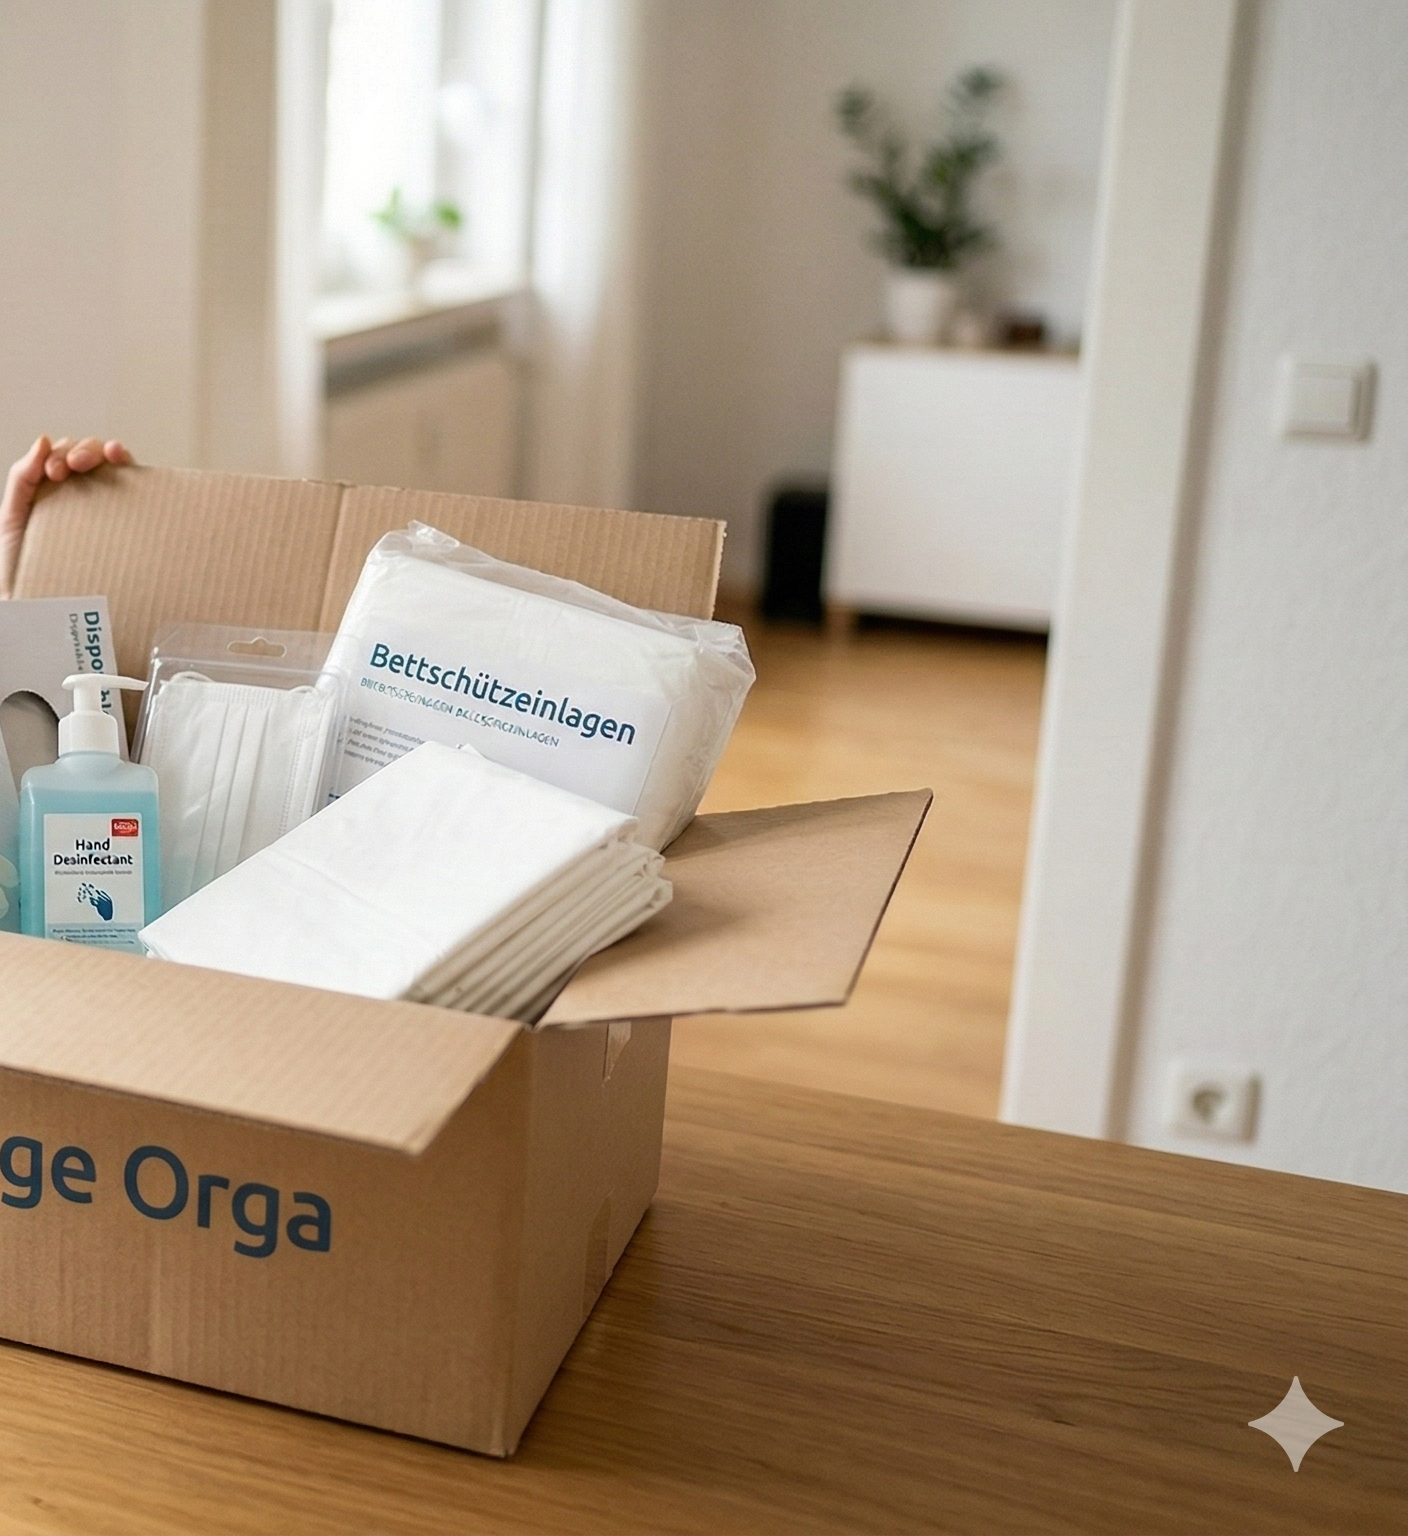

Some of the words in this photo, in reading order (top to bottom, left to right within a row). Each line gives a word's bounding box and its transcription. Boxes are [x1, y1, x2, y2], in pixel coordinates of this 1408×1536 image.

[370, 643, 636, 745] Bettschützeinlagen
[75, 837, 110, 851] Hand
[124, 1145, 332, 1258] Orga
